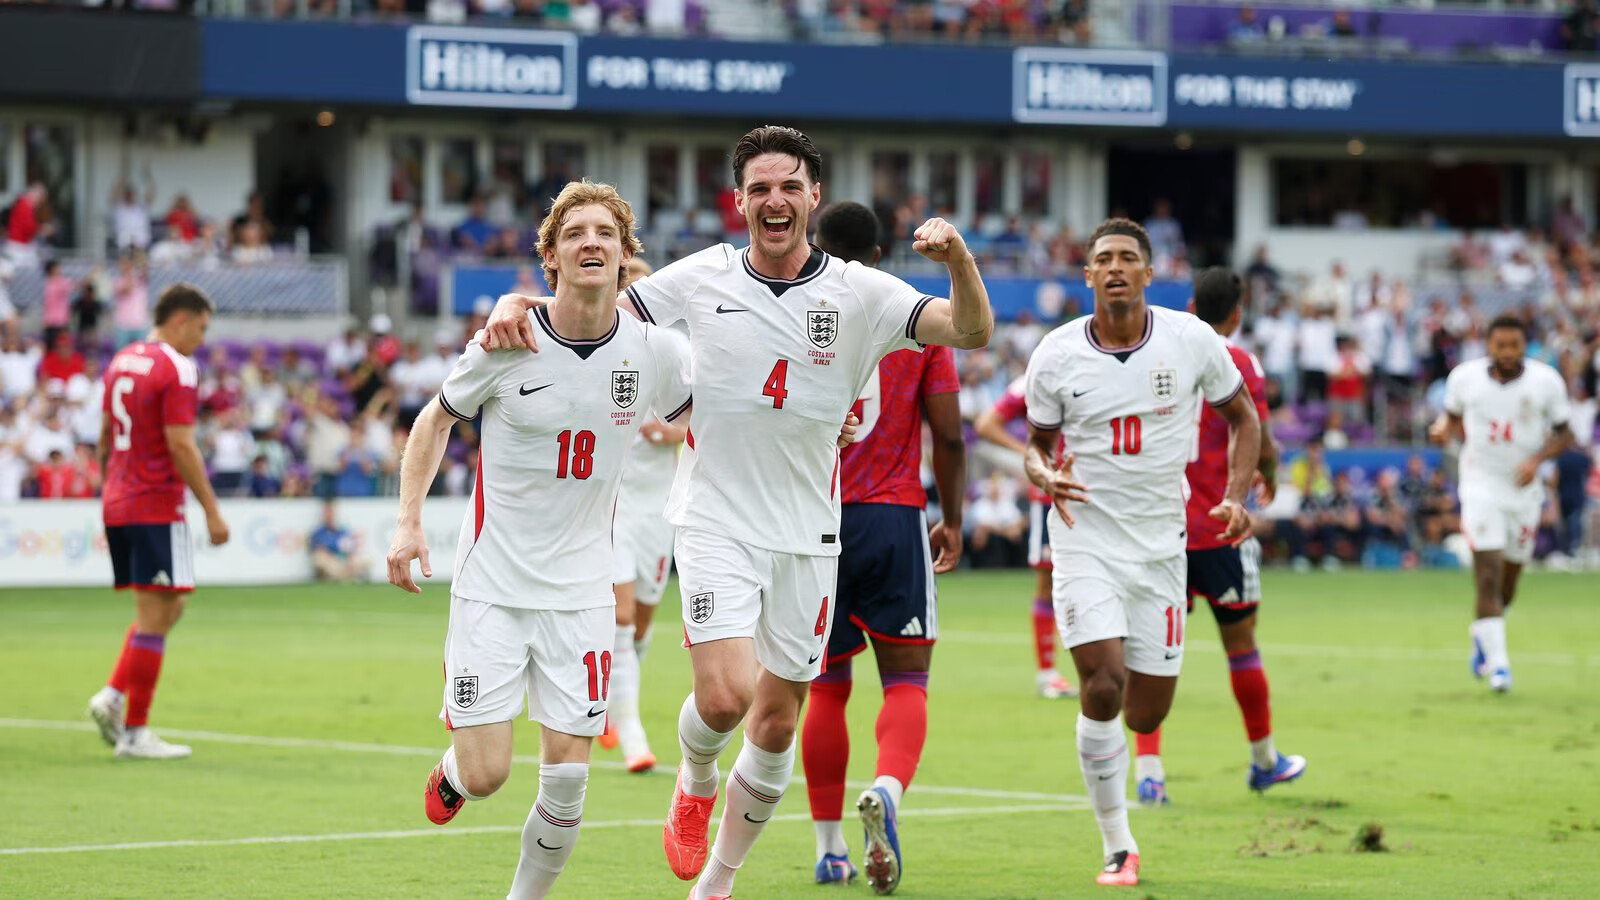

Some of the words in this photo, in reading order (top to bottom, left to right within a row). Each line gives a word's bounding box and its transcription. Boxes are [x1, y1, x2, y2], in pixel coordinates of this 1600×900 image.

[422, 41, 562, 94] Hilton
[587, 55, 649, 88] FOR
[652, 58, 711, 91] THE
[715, 60, 788, 93] STAY
[1027, 62, 1153, 111] Hilton
[1174, 74, 1230, 106] FOR
[1234, 76, 1288, 109] THE
[1291, 78, 1356, 111] STAY
[807, 349, 825, 358] COSTA
[762, 358, 789, 409] 4
[111, 376, 135, 451] 5
[610, 411, 626, 419] COSTA
[1110, 415, 1141, 455] 10
[1488, 421, 1514, 444] 24
[556, 429, 596, 480] 18
[814, 595, 829, 642] 4
[583, 651, 612, 701] 18
